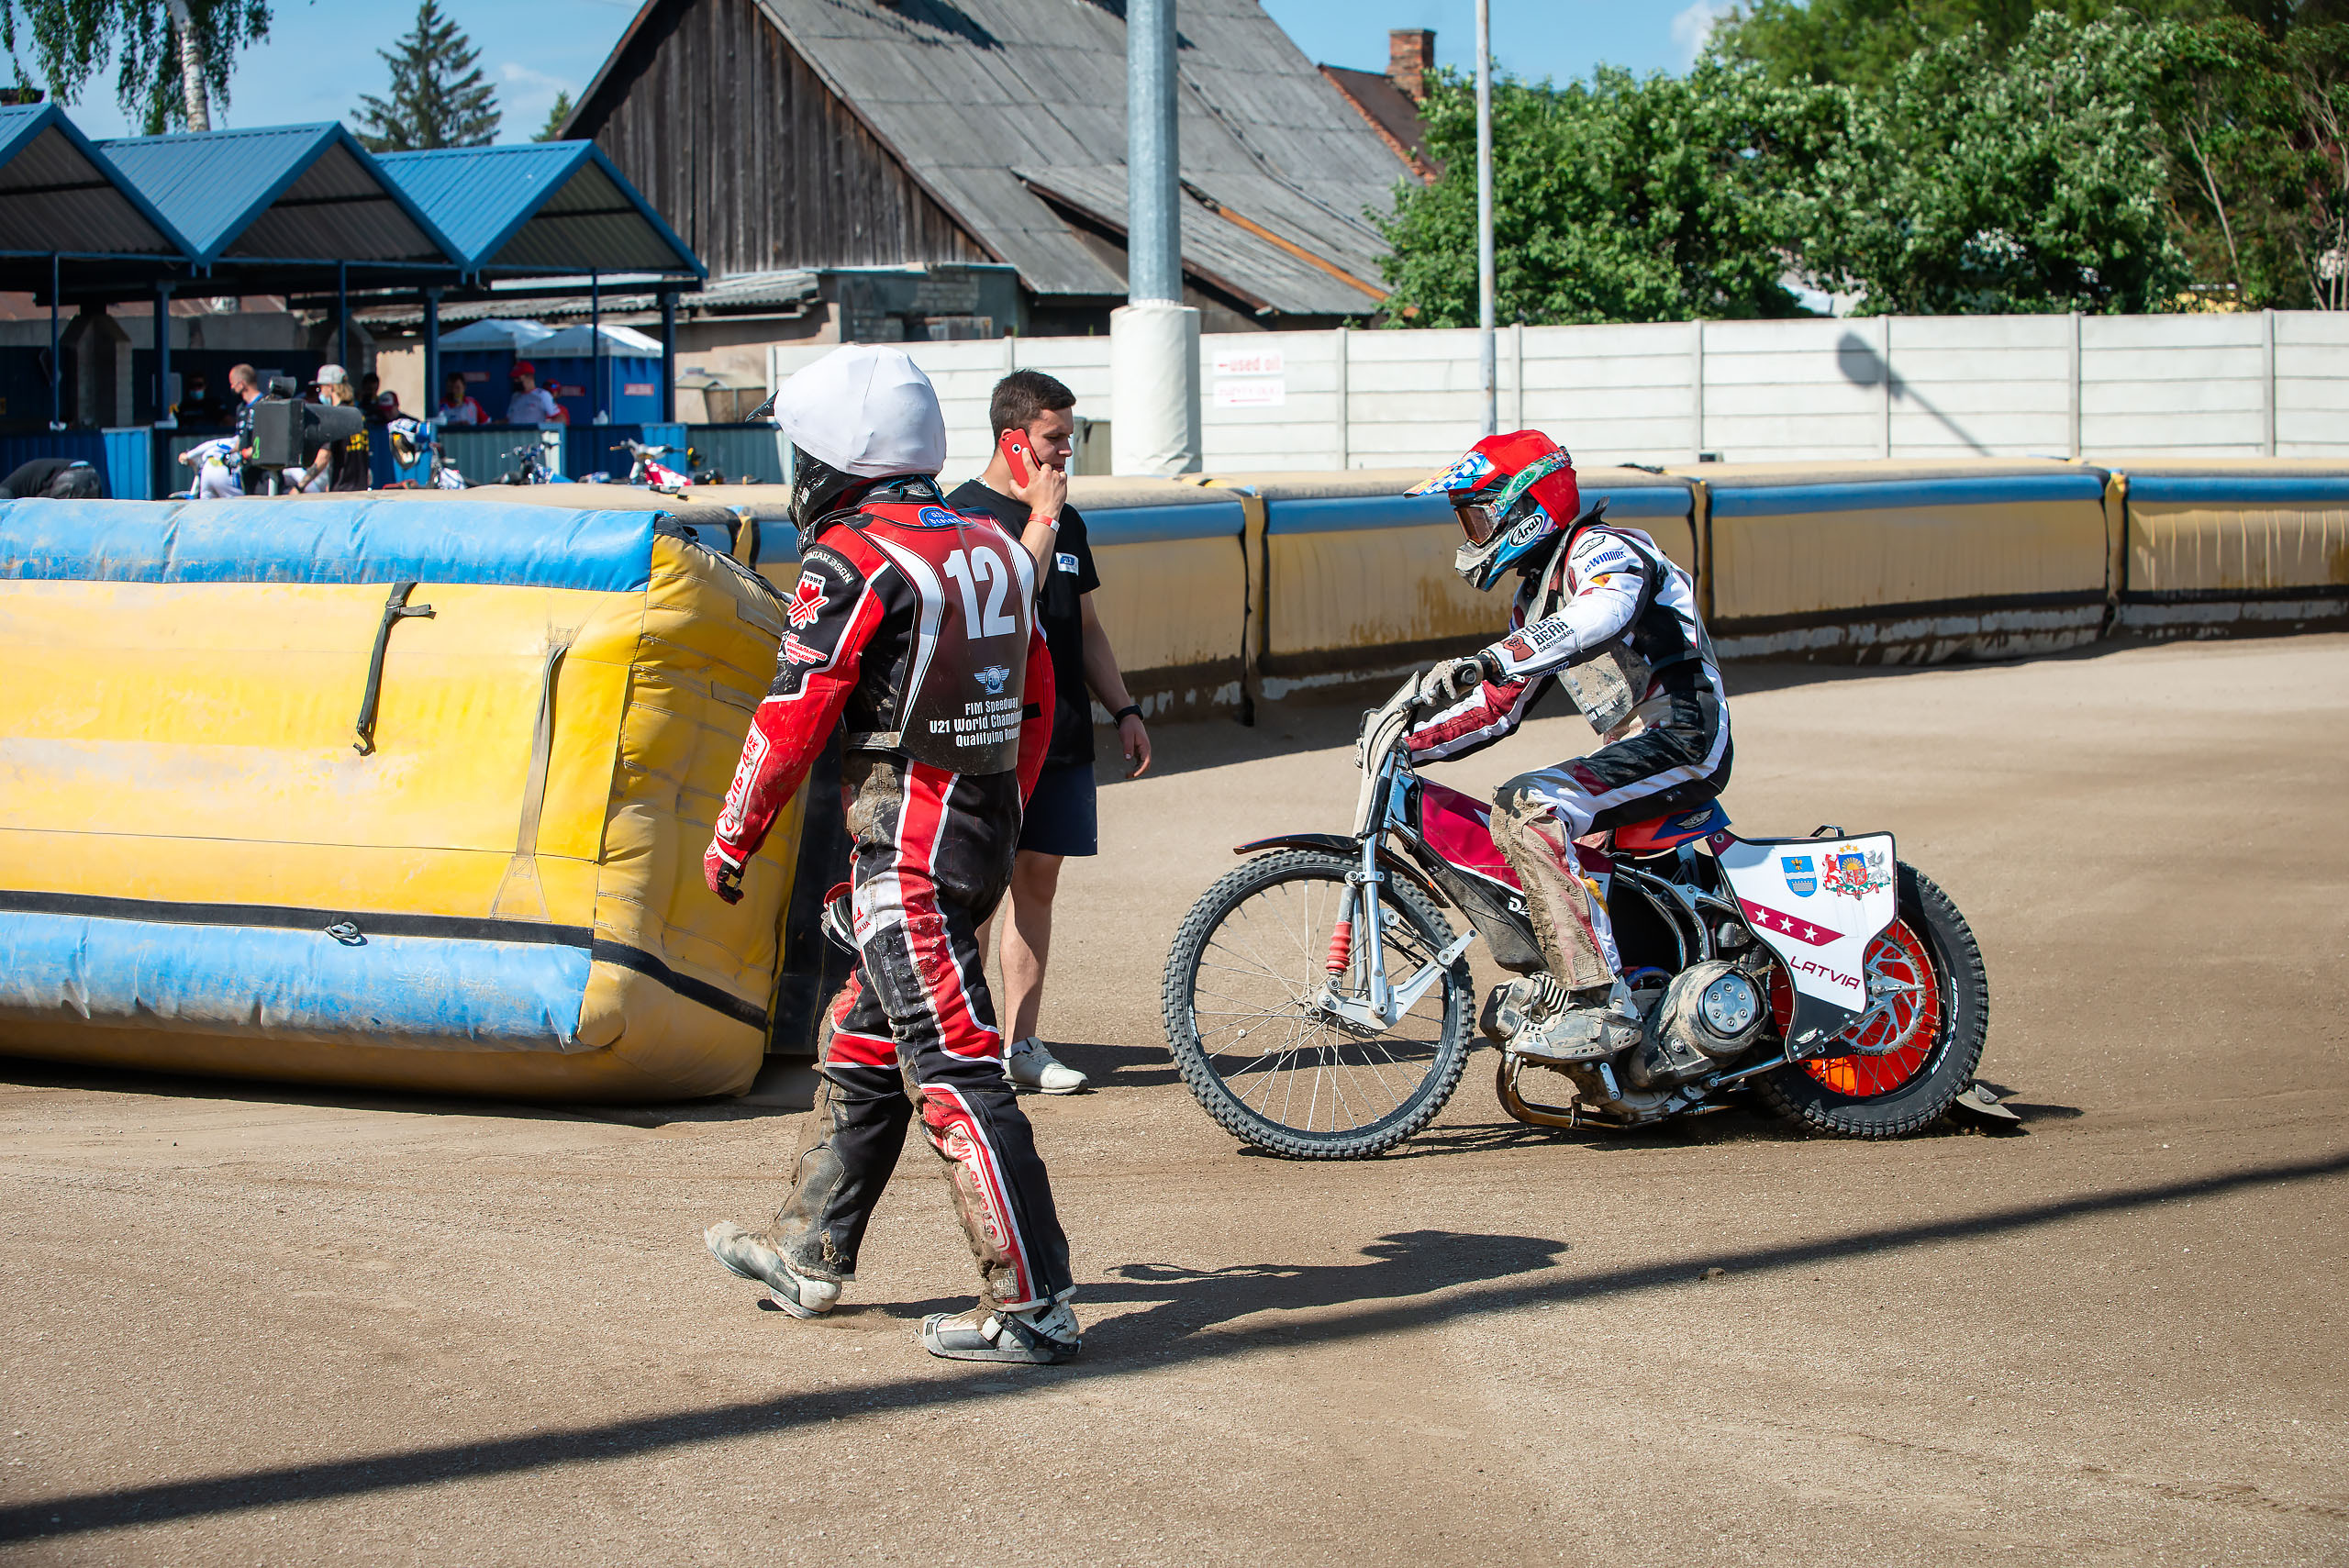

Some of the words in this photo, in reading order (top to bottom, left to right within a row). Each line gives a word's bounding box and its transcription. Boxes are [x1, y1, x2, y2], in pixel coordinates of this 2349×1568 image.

[1230, 356, 1261, 372] used
[1515, 517, 1540, 544] Arai
[942, 546, 1016, 639] 12
[1532, 621, 1569, 646] BEAR
[965, 701, 984, 716] FIM
[985, 697, 1019, 714] Speedway
[1595, 700, 1615, 717] Round
[930, 720, 951, 734] U21
[954, 716, 988, 732] World
[955, 729, 1004, 748] Qualifying
[1789, 956, 1861, 990] LATVIA
